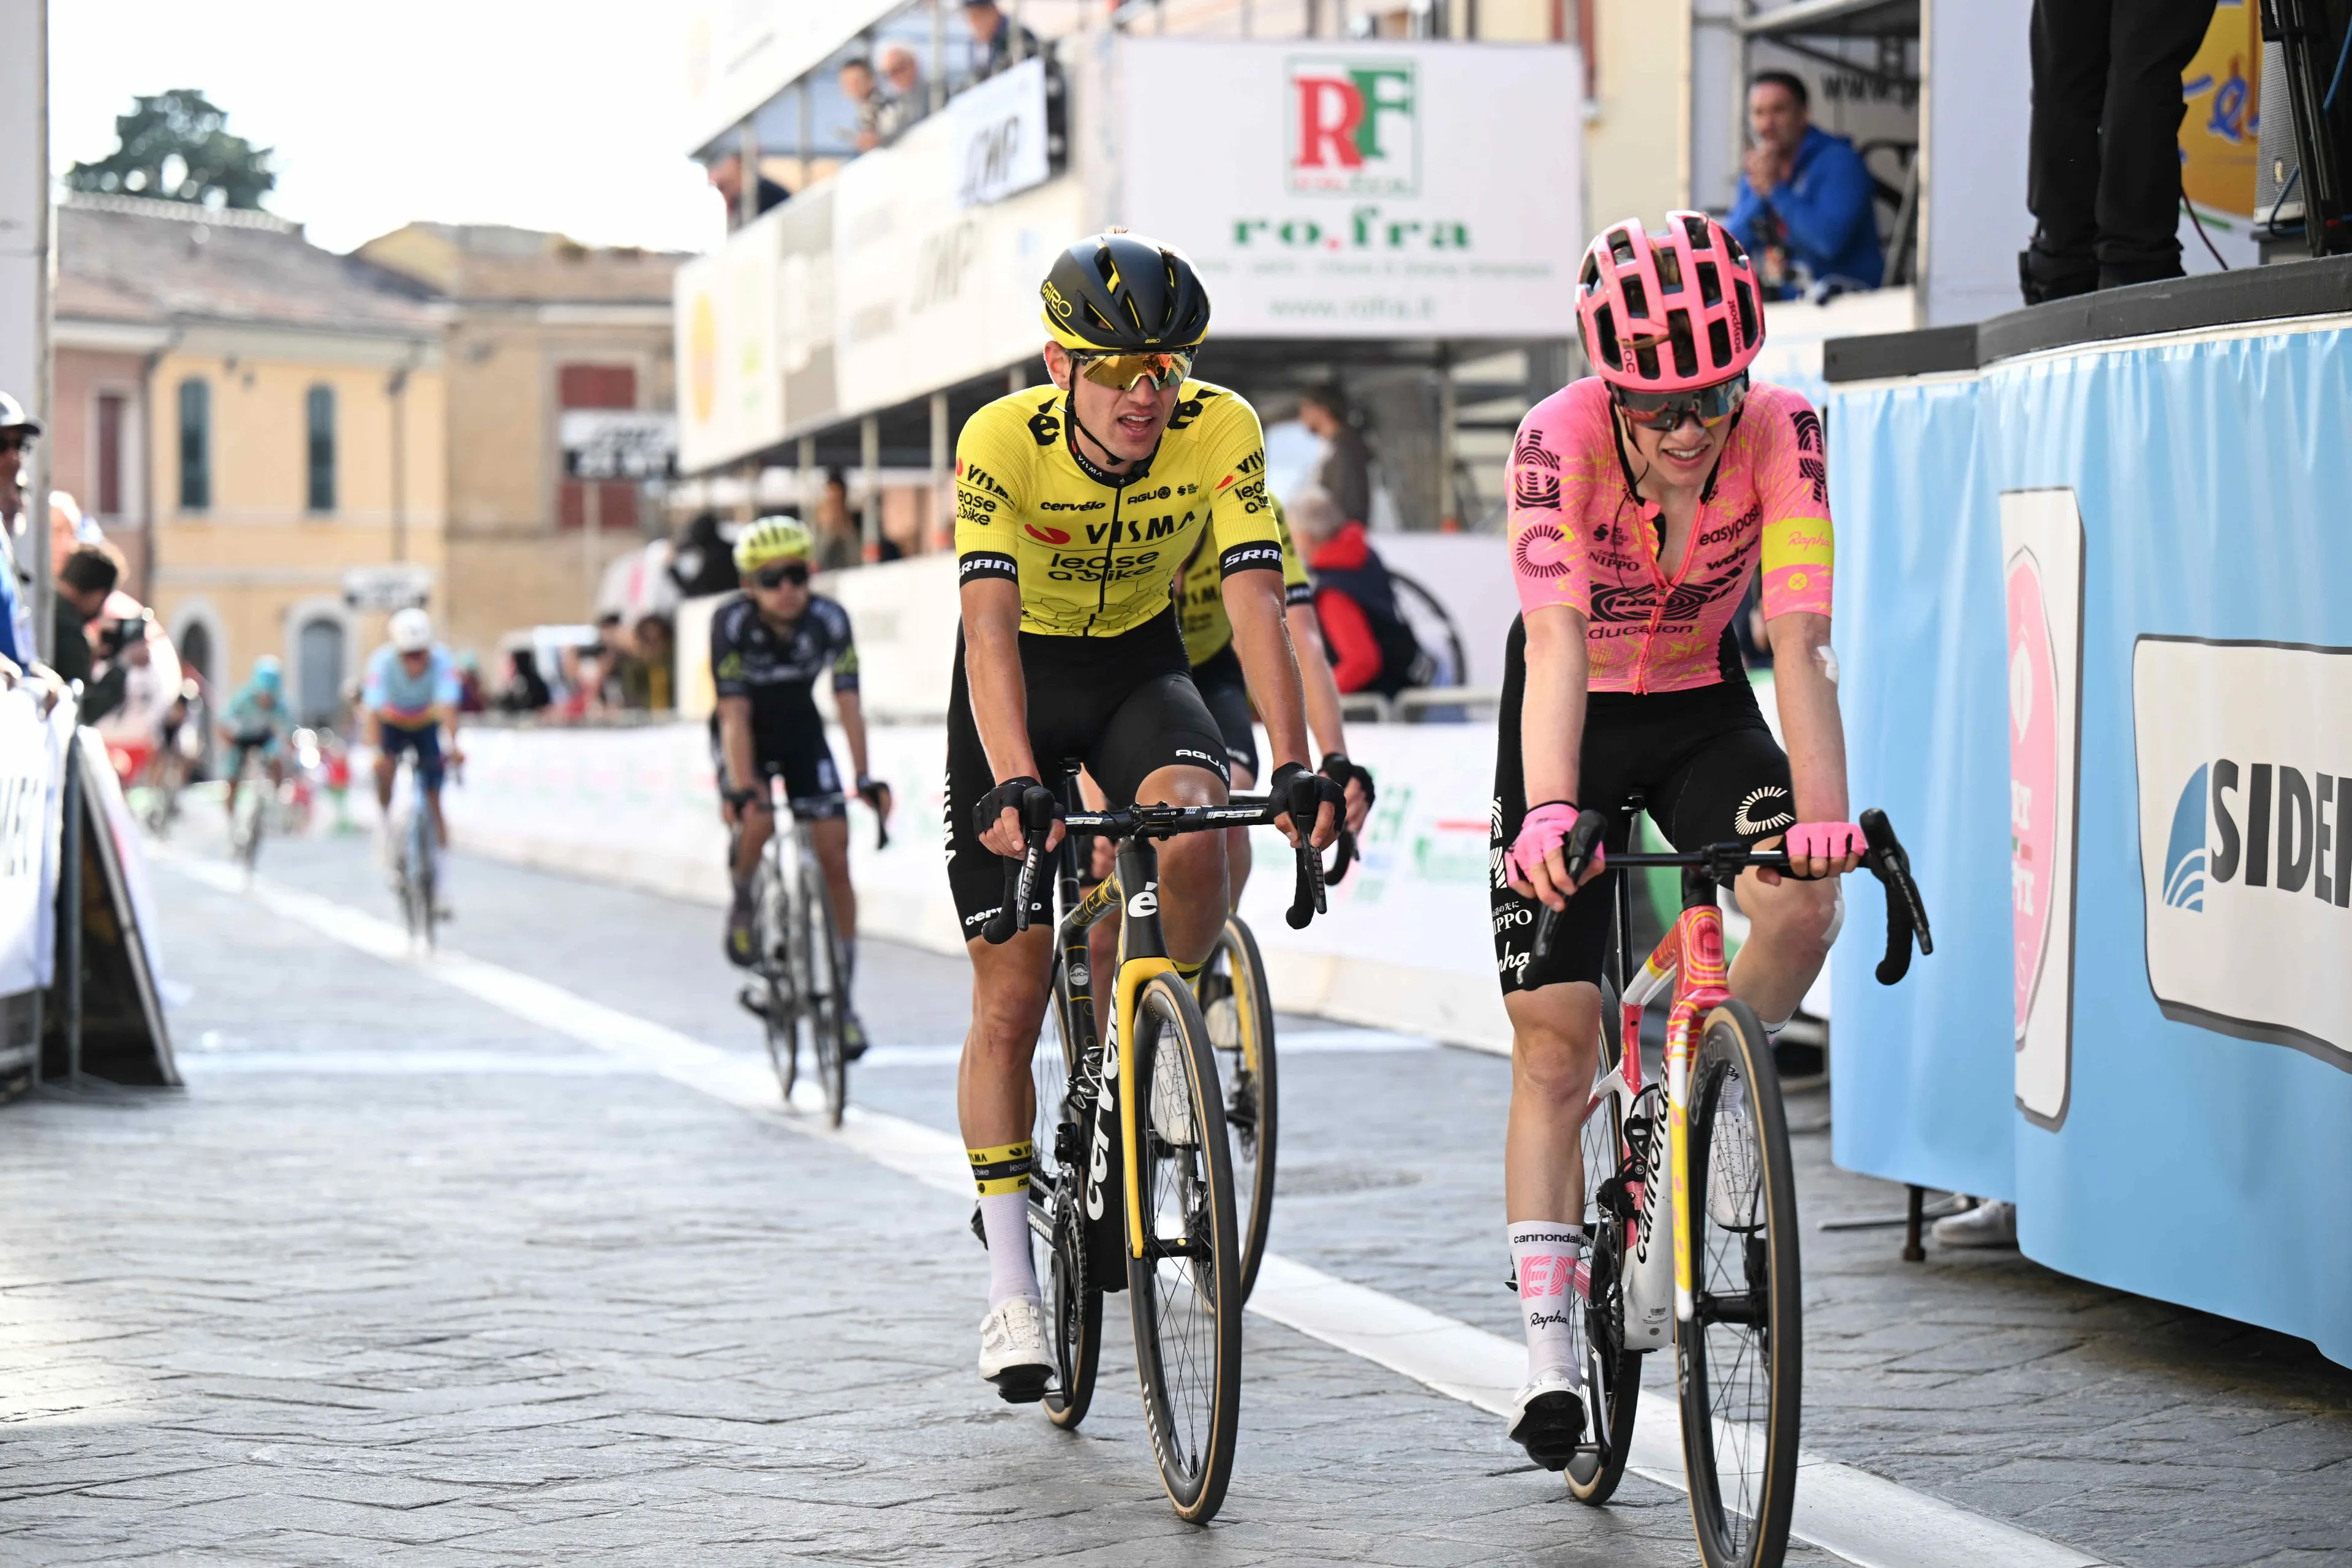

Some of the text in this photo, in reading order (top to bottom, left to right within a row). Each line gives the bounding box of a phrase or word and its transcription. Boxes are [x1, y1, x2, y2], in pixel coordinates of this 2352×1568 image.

[1233, 206, 1474, 249] ro.fra
[1042, 281, 1072, 317] GIRO
[1727, 300, 1741, 354] easypost
[1078, 454, 1102, 477] VISMA
[1040, 501, 1106, 511] cervélo
[1128, 490, 1157, 505] AGU
[1086, 511, 1196, 545] VISMA
[1700, 503, 1761, 546] easypost
[1706, 534, 1758, 571] wahoo
[1789, 531, 1831, 551] Rapha
[959, 559, 1016, 579] RAM
[1050, 551, 1159, 568] lease
[1588, 551, 1640, 571] NIPPO
[1175, 749, 1219, 767] AGU
[1019, 846, 1038, 913] SRAM
[1493, 909, 1532, 935] IPPO
[1513, 1233, 1581, 1245] cannondale
[1143, 1382, 1167, 1470] RESERVE
